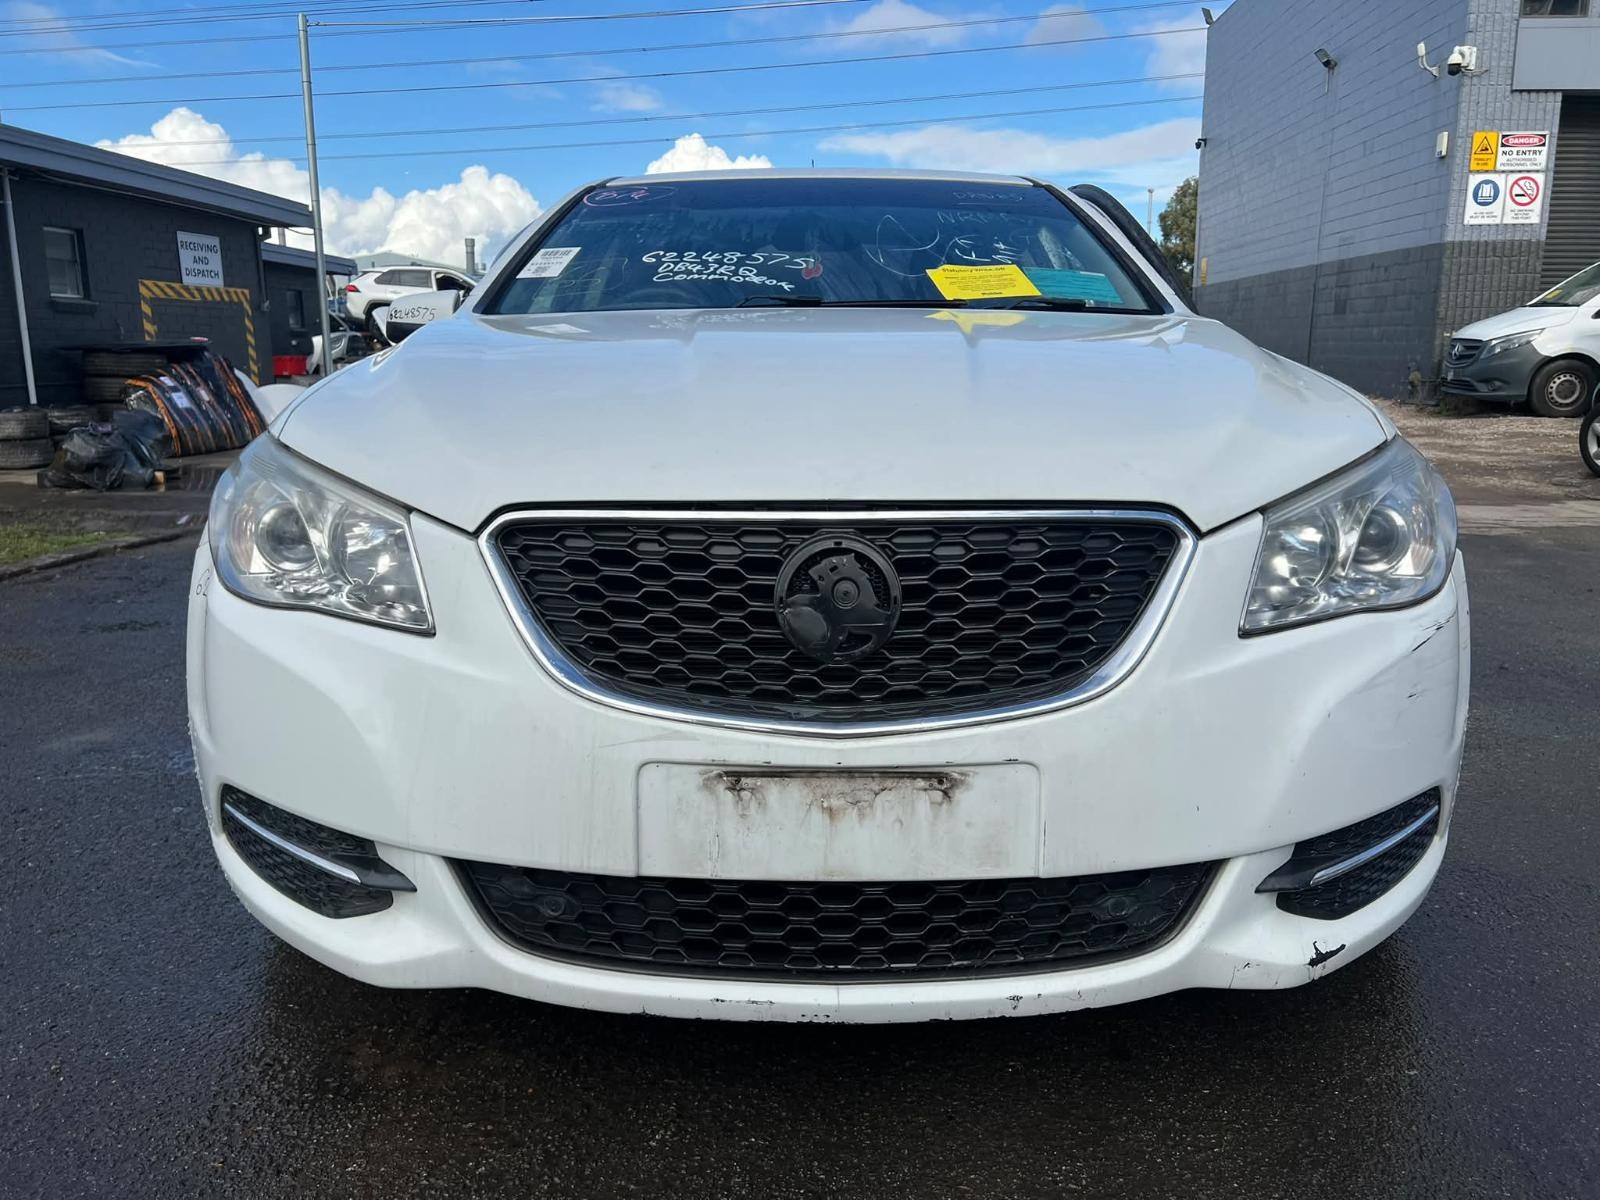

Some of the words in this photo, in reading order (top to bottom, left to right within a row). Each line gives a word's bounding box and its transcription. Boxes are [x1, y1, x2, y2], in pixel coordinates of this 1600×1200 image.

[180, 240, 219, 254] RECEIVING
[193, 255, 209, 265] AND
[642, 250, 815, 269] 62248575
[185, 267, 219, 279] DISPATCH
